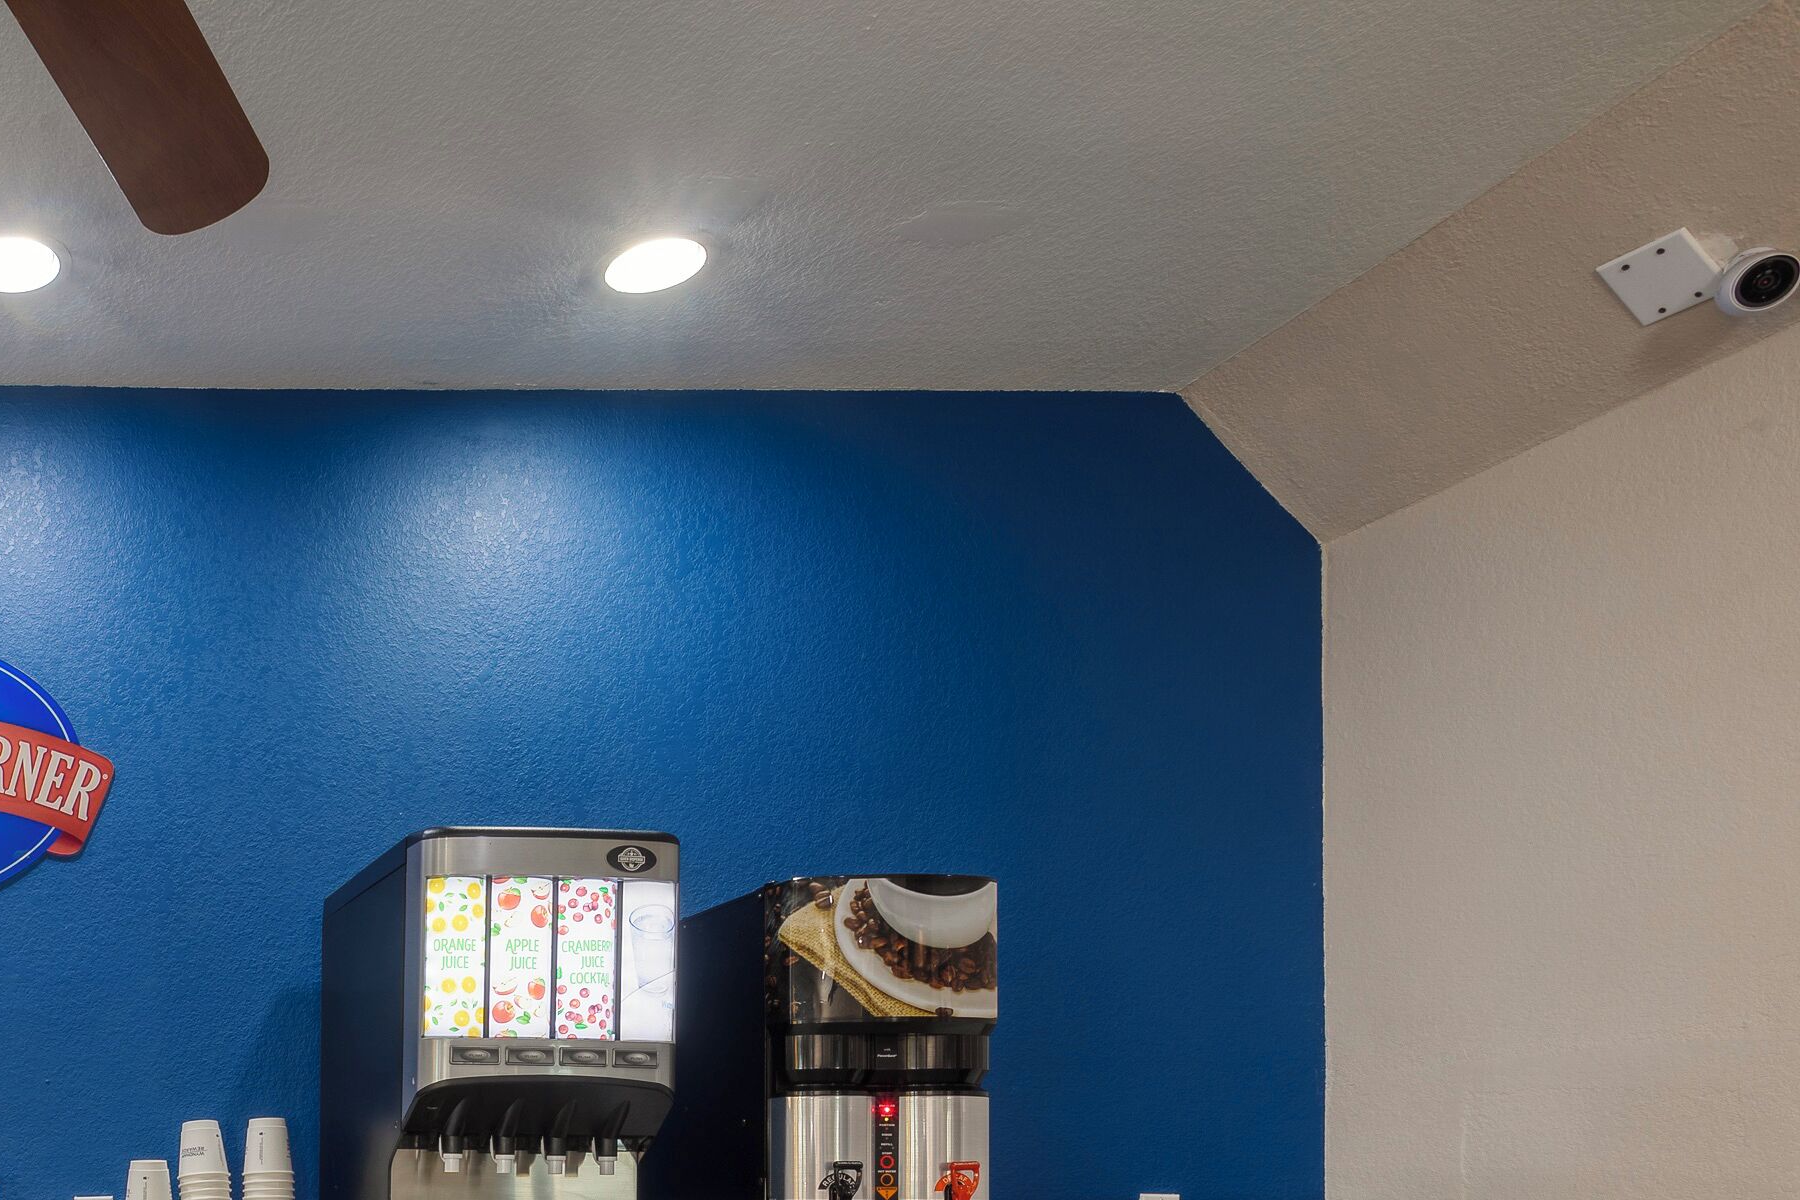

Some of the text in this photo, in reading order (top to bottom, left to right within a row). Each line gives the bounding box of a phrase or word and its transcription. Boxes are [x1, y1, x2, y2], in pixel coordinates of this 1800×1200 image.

[433, 938, 476, 954] ORANGE
[505, 938, 540, 955] APPLE
[561, 939, 613, 955] CRANBERRY
[441, 955, 469, 970] JUICE
[508, 956, 537, 971] JUICE
[580, 955, 605, 970] JUICE
[569, 972, 611, 987] COCKTAIL
[942, 1174, 968, 1184] DEAF
